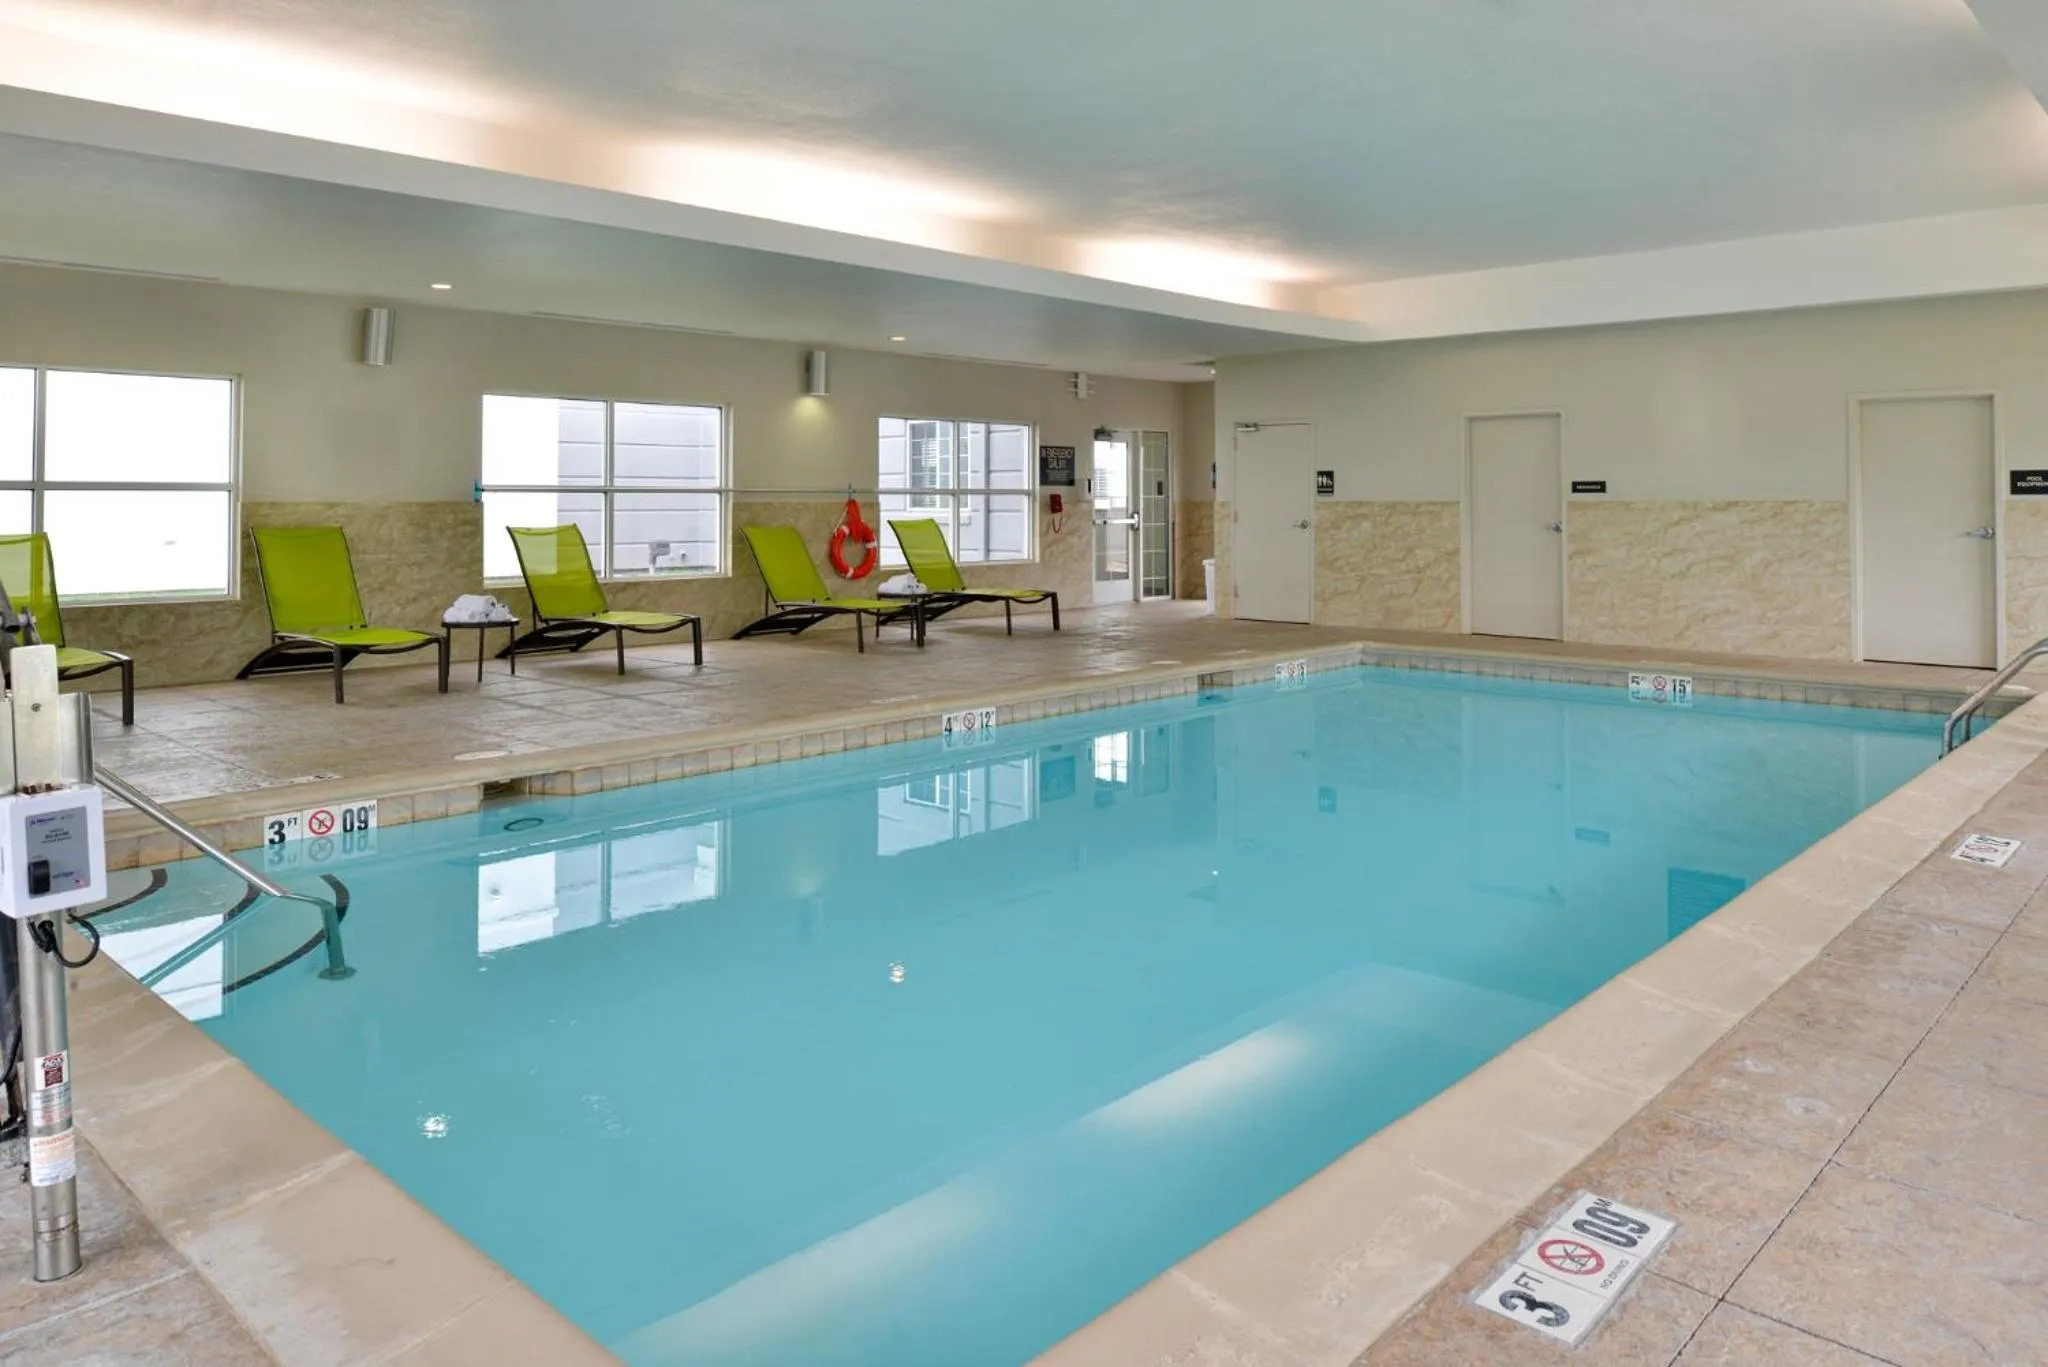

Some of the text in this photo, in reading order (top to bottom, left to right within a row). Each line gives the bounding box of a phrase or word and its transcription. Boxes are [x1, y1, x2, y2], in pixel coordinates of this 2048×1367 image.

[944, 716, 953, 733] 4
[268, 820, 286, 845] 3
[1498, 1290, 1571, 1328] 3
